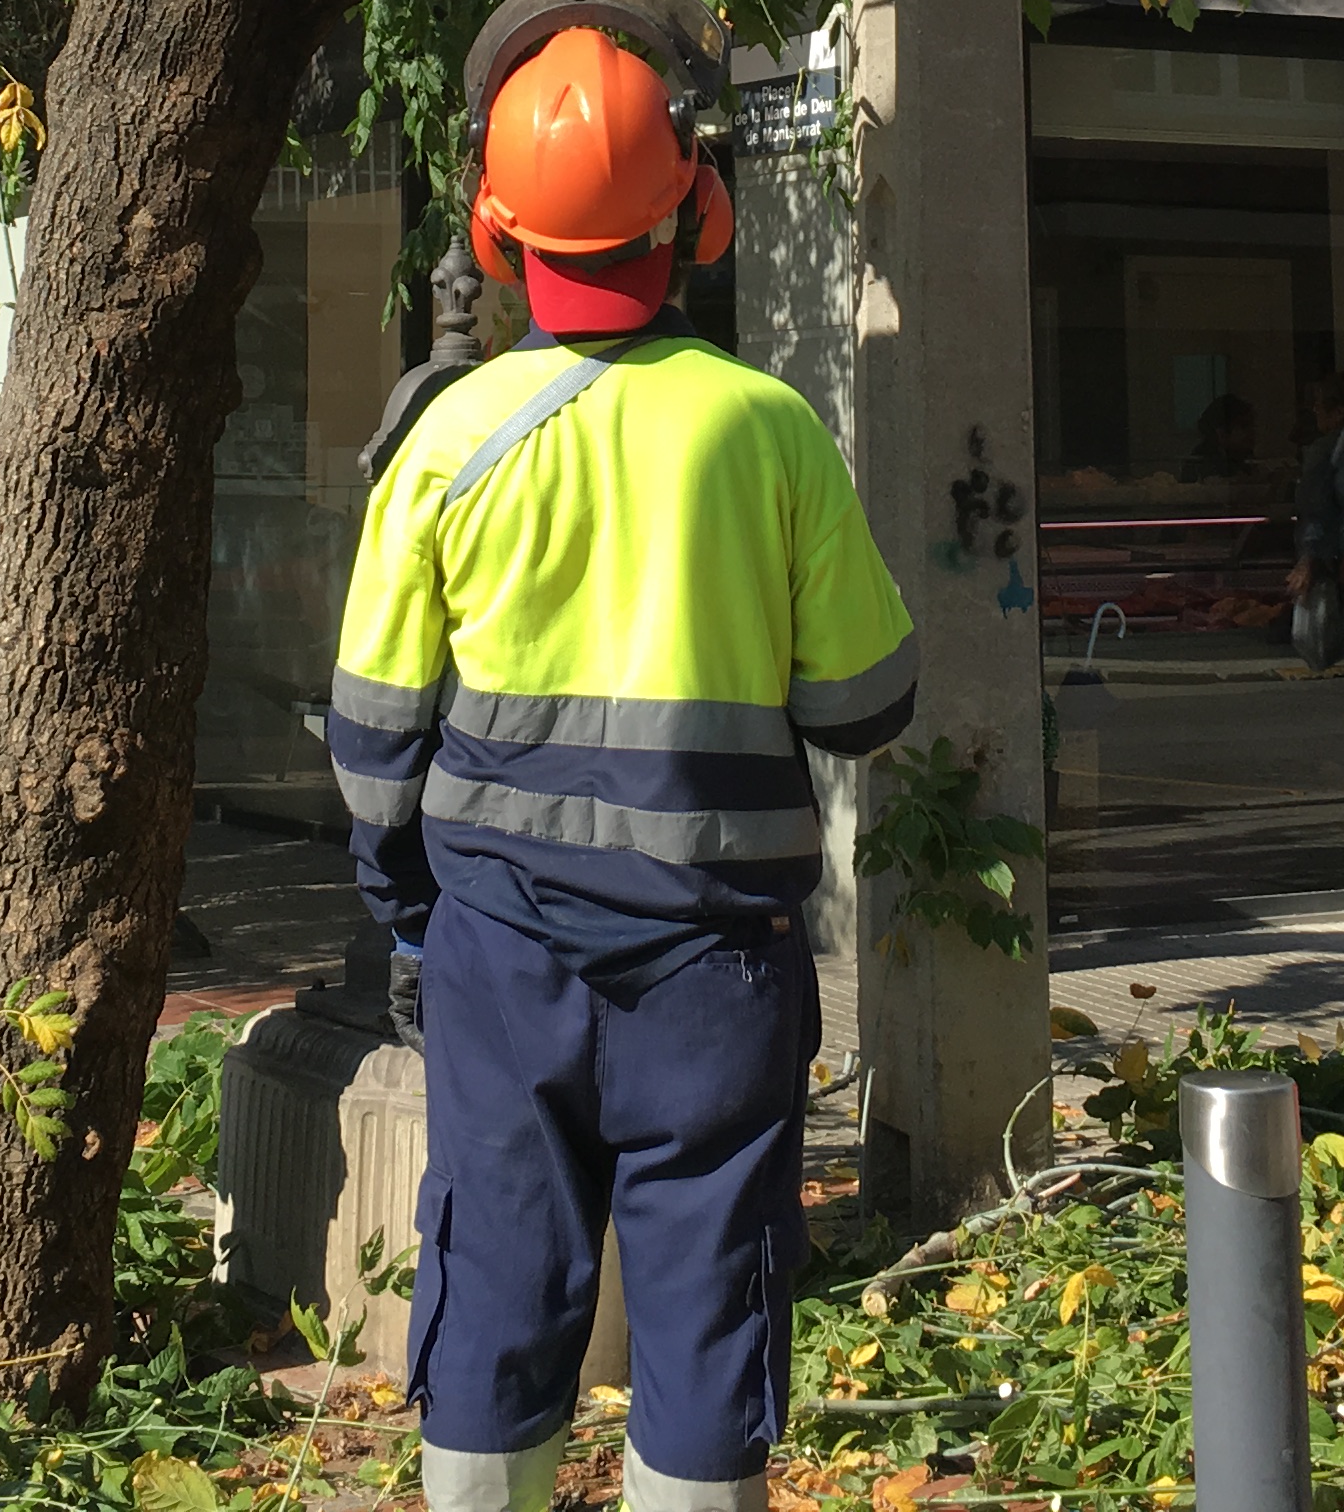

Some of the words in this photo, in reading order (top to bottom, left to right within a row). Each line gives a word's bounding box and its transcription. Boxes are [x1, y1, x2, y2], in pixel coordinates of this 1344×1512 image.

[734, 112, 748, 126] de
[751, 108, 761, 123] la
[764, 104, 790, 122] Mare
[794, 100, 807, 117] de
[745, 129, 759, 146] de
[762, 120, 822, 144] Montserrat
